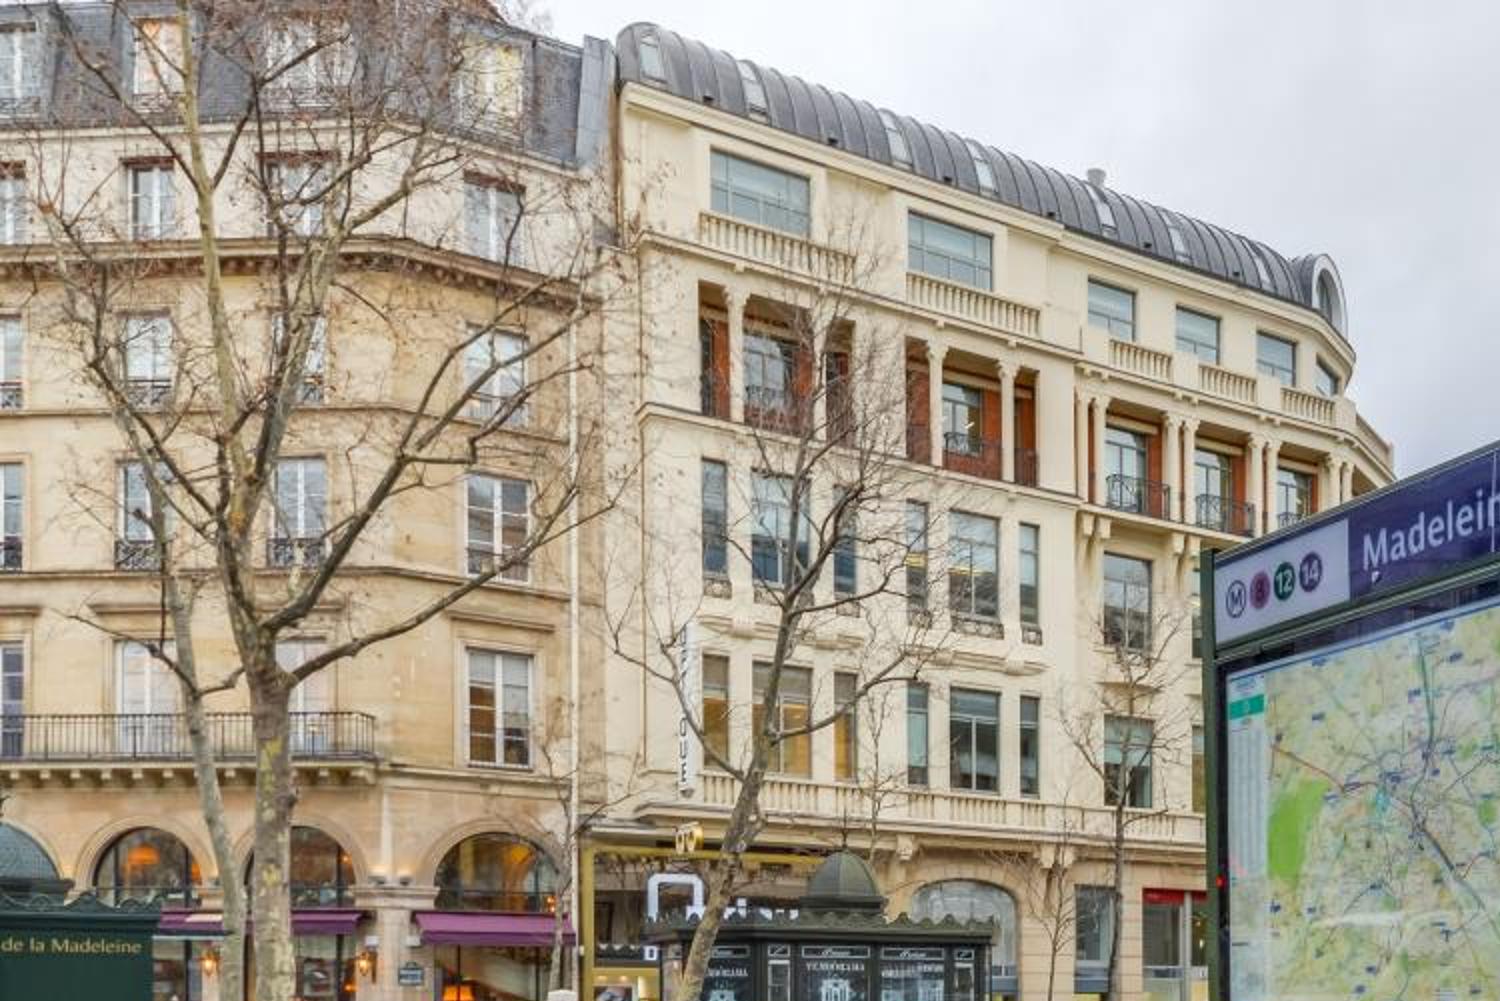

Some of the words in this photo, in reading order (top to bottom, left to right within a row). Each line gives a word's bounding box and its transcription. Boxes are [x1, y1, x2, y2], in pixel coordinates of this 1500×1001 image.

[1276, 569, 1293, 596] 12
[1302, 559, 1318, 586] 14
[1, 936, 24, 953] de
[30, 937, 45, 953] la
[51, 937, 142, 953] Madeleine
